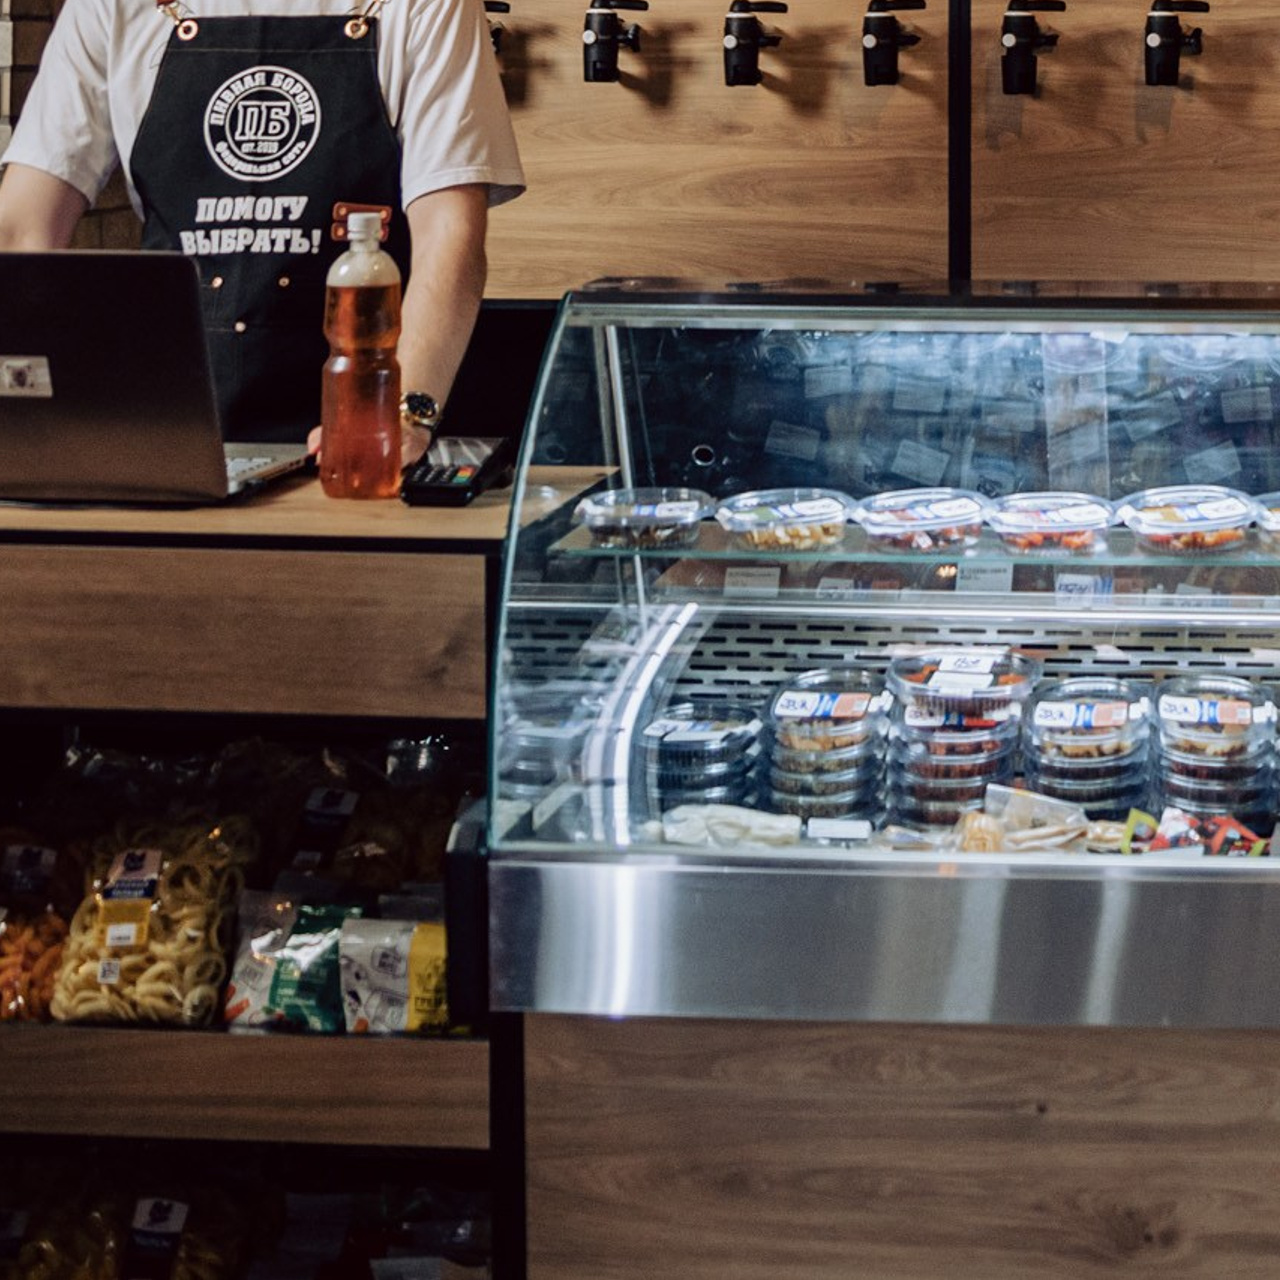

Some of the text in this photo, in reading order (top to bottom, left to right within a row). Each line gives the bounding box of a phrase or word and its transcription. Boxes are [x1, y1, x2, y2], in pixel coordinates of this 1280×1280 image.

[210, 72, 315, 126] ПИВНАЯ БОРОДА
[195, 195, 308, 223] ПОМОГУ
[179, 227, 322, 255] ВЫБРАТЬ!
